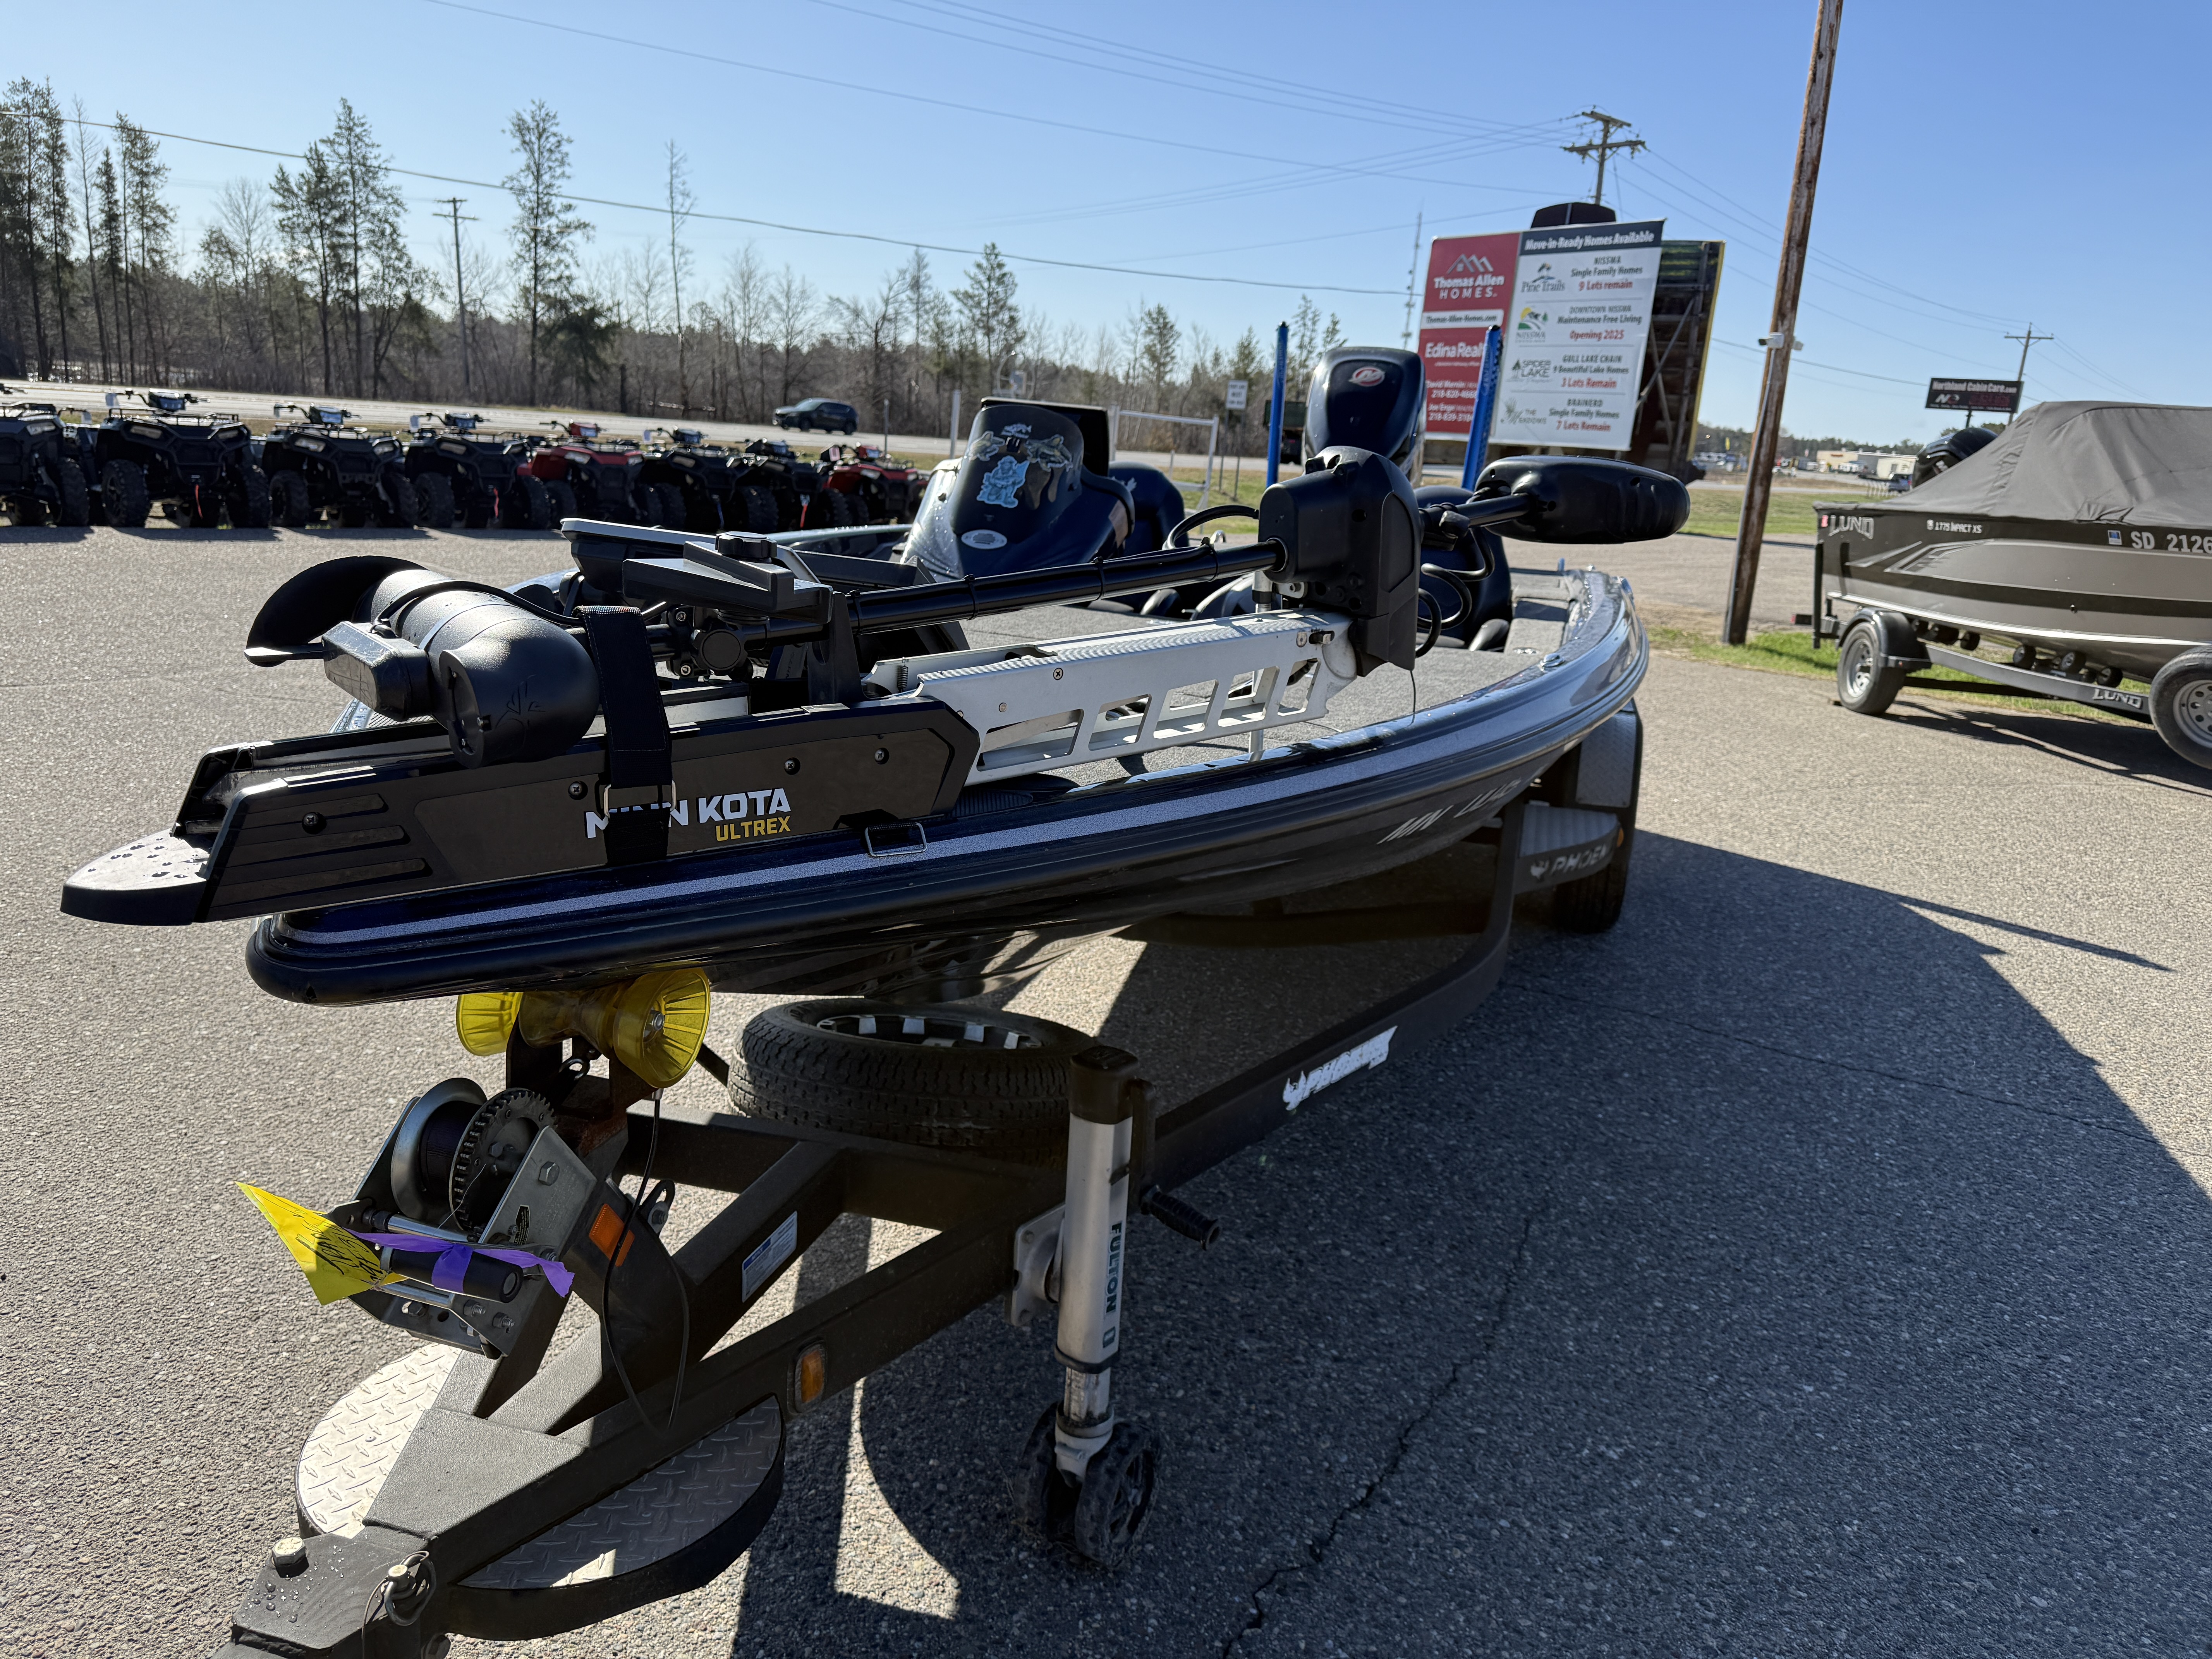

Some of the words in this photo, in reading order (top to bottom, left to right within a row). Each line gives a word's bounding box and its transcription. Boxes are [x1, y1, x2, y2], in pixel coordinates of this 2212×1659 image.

[1583, 235, 1613, 247] Homes
[1613, 230, 1655, 244] Available
[1570, 268, 1592, 278] Single
[1593, 266, 1616, 277] Family
[1617, 266, 1643, 275] Homes
[1434, 276, 1475, 289] Thomas
[1475, 274, 1505, 287] Allen
[1522, 280, 1540, 292] Pine
[1542, 279, 1565, 291] Trails
[1586, 280, 1603, 290] Lots
[1604, 278, 1633, 290] remain
[1557, 315, 1602, 324] Maintenance
[1602, 314, 1618, 323] Free
[1620, 314, 1643, 325] Living
[1570, 329, 1602, 342] Opening
[1603, 328, 1625, 340] 2025
[1425, 342, 1456, 358] Edina
[1581, 354, 1599, 363] LAKE
[1521, 368, 1550, 378] LAKE
[1559, 364, 1587, 374] Beautiful
[1588, 365, 1605, 374] Lake
[1606, 366, 1629, 374] Homes
[1567, 377, 1584, 388] Lots
[1585, 377, 1617, 389] Remain
[1932, 380, 1967, 392] Northland
[1967, 381, 1987, 392] Cabin
[1549, 408, 1570, 419] Single
[1571, 409, 1594, 420] Family
[1595, 410, 1620, 419] Homes
[1563, 420, 1580, 430] Lots
[1581, 421, 1611, 432] Remain
[1828, 515, 1874, 539] LUND
[1934, 522, 1950, 531] 1775
[1972, 524, 1982, 534] XS
[2131, 531, 2155, 550] SD
[2092, 689, 2142, 708] LUND
[586, 799, 689, 838] MN
[698, 788, 791, 824] KOTA
[716, 816, 791, 842] ULTREX
[1106, 1222, 1122, 1313] FULTON
